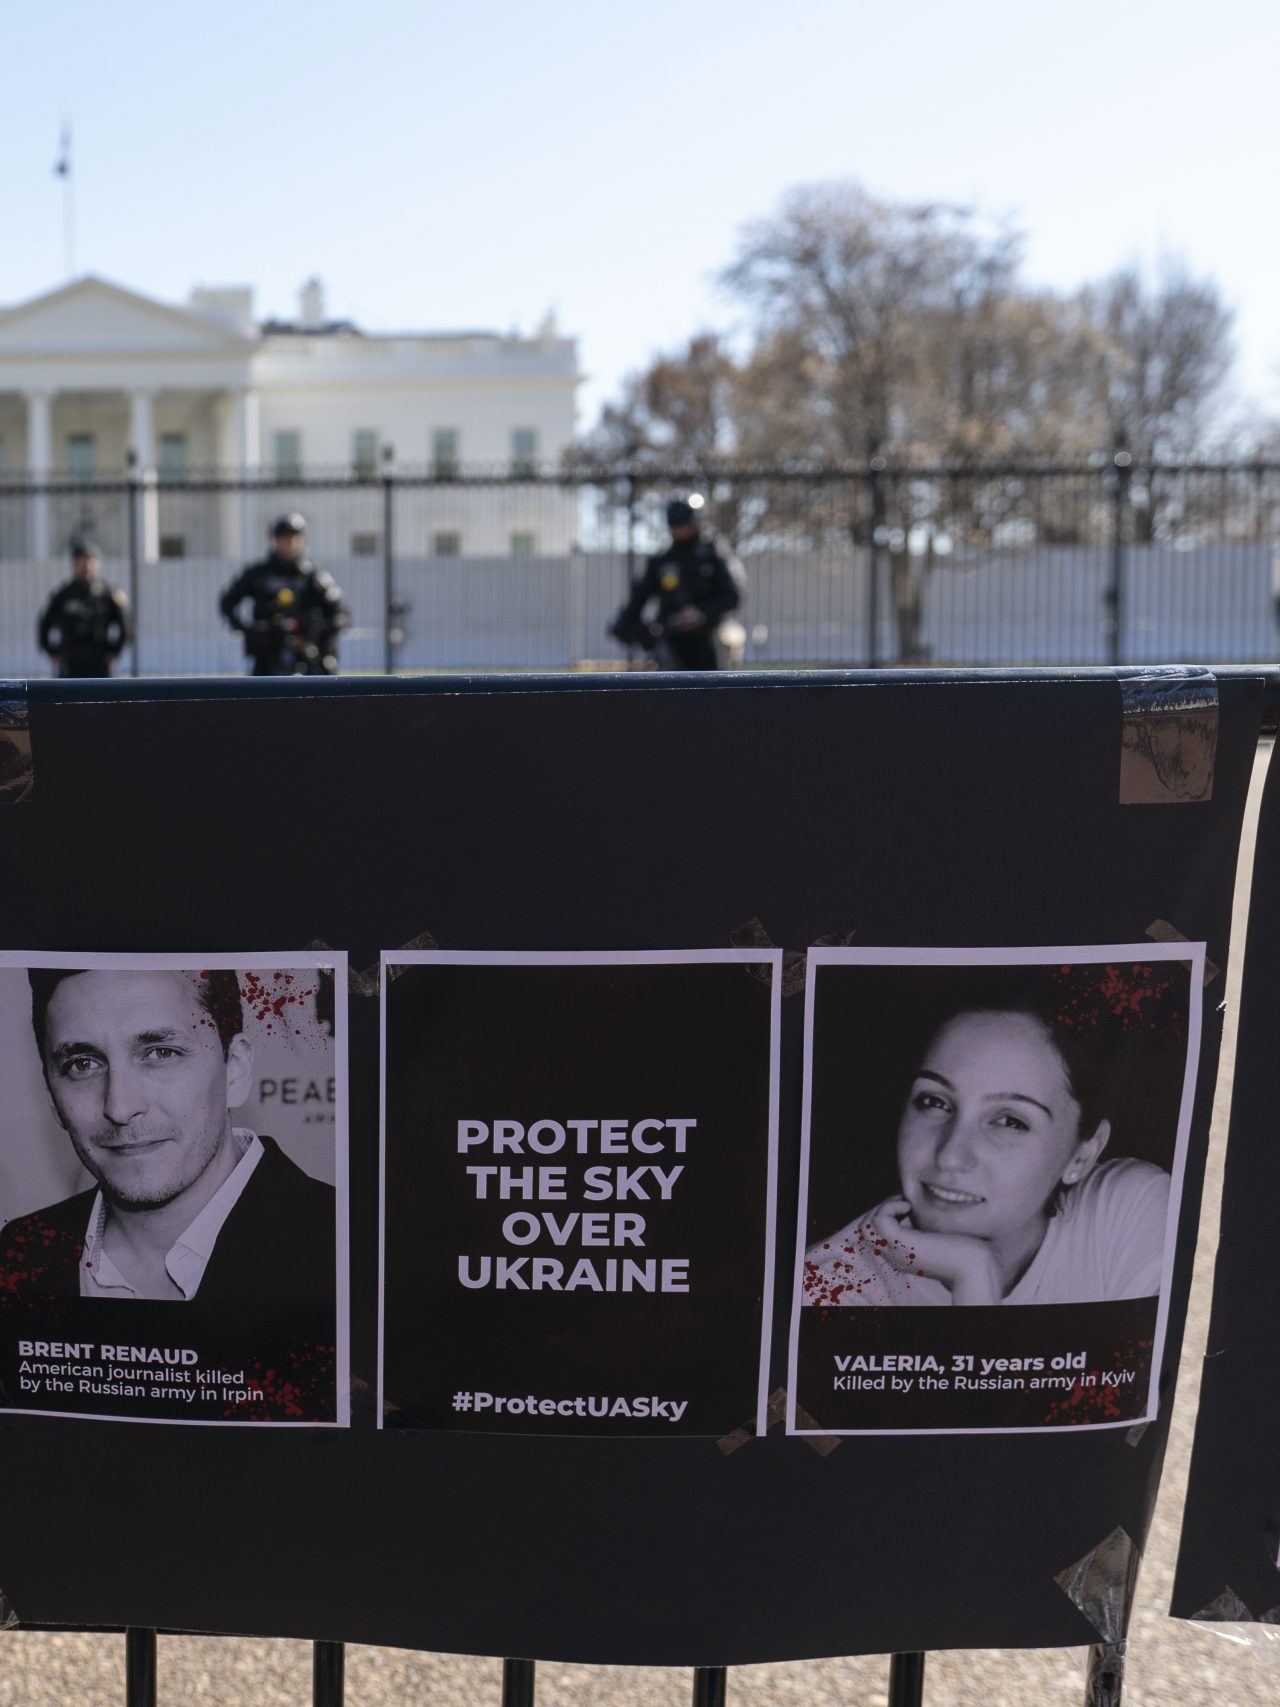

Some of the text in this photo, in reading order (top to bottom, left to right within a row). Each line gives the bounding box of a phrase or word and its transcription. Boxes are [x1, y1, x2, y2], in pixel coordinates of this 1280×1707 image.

[457, 1118, 698, 1155] PROTECT
[465, 1164, 685, 1202] THE SKY
[501, 1211, 647, 1247] OVER
[457, 1254, 691, 1293] UKRAINE
[18, 1340, 199, 1366] BRENT RENAUD
[833, 1351, 1087, 1376] VALERIA, 31 years old
[19, 1360, 244, 1385] American journalist killed
[833, 1368, 1136, 1393] Killed by the Russian army in Kyiv
[20, 1375, 265, 1405] by the Russian army in Irpin
[451, 1391, 689, 1423] #ProtectUASky
